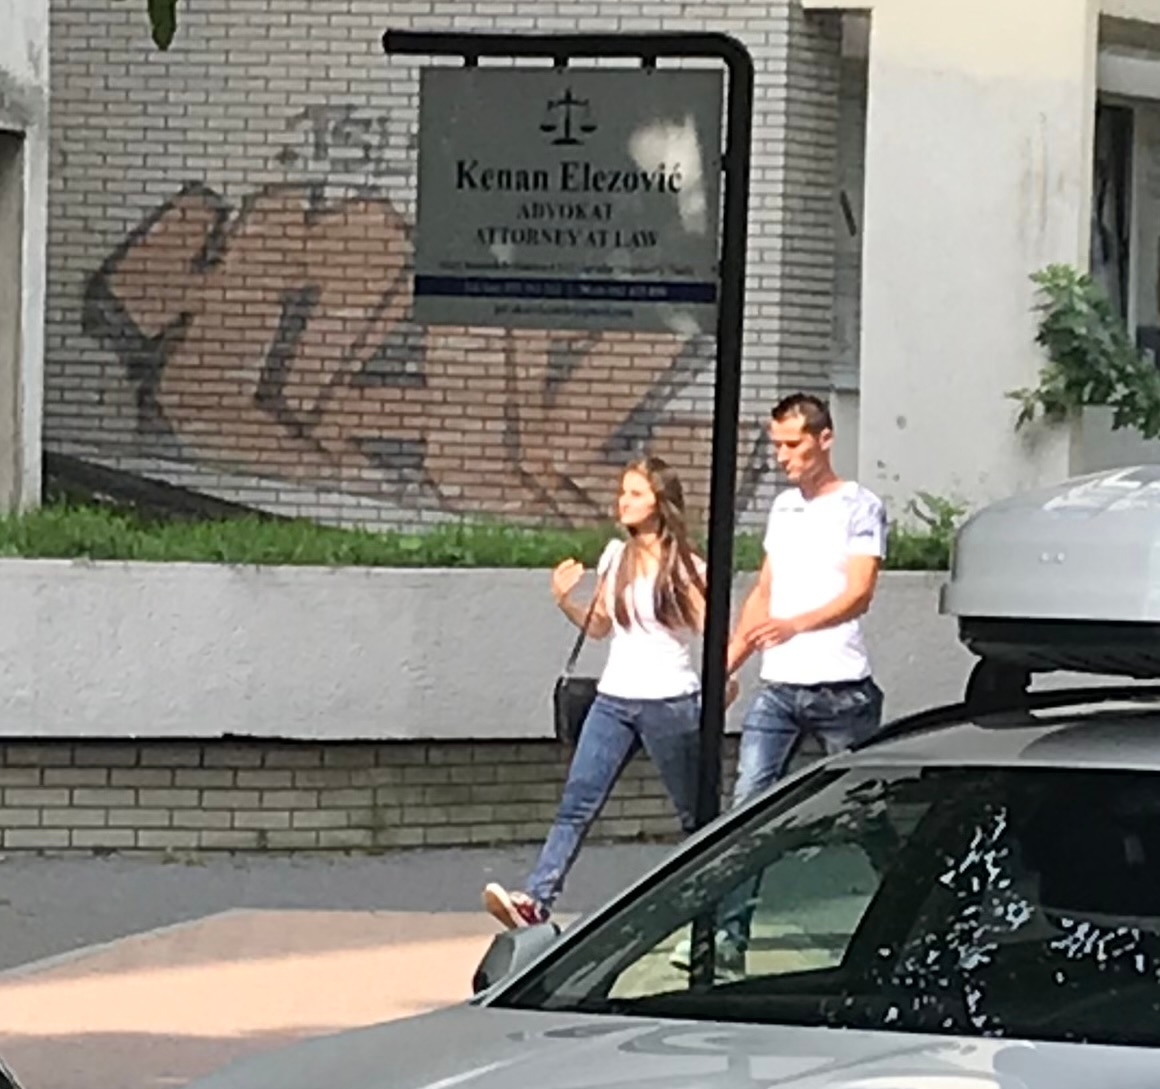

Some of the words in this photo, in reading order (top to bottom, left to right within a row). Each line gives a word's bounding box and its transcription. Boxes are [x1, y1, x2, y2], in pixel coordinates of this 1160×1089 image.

[456, 160, 549, 193] Kenan
[560, 161, 683, 194] Elezović
[517, 202, 613, 221] ADVOKAT
[476, 226, 580, 246] ATTORNEY
[586, 229, 608, 248] AT
[614, 230, 659, 249] LAW
